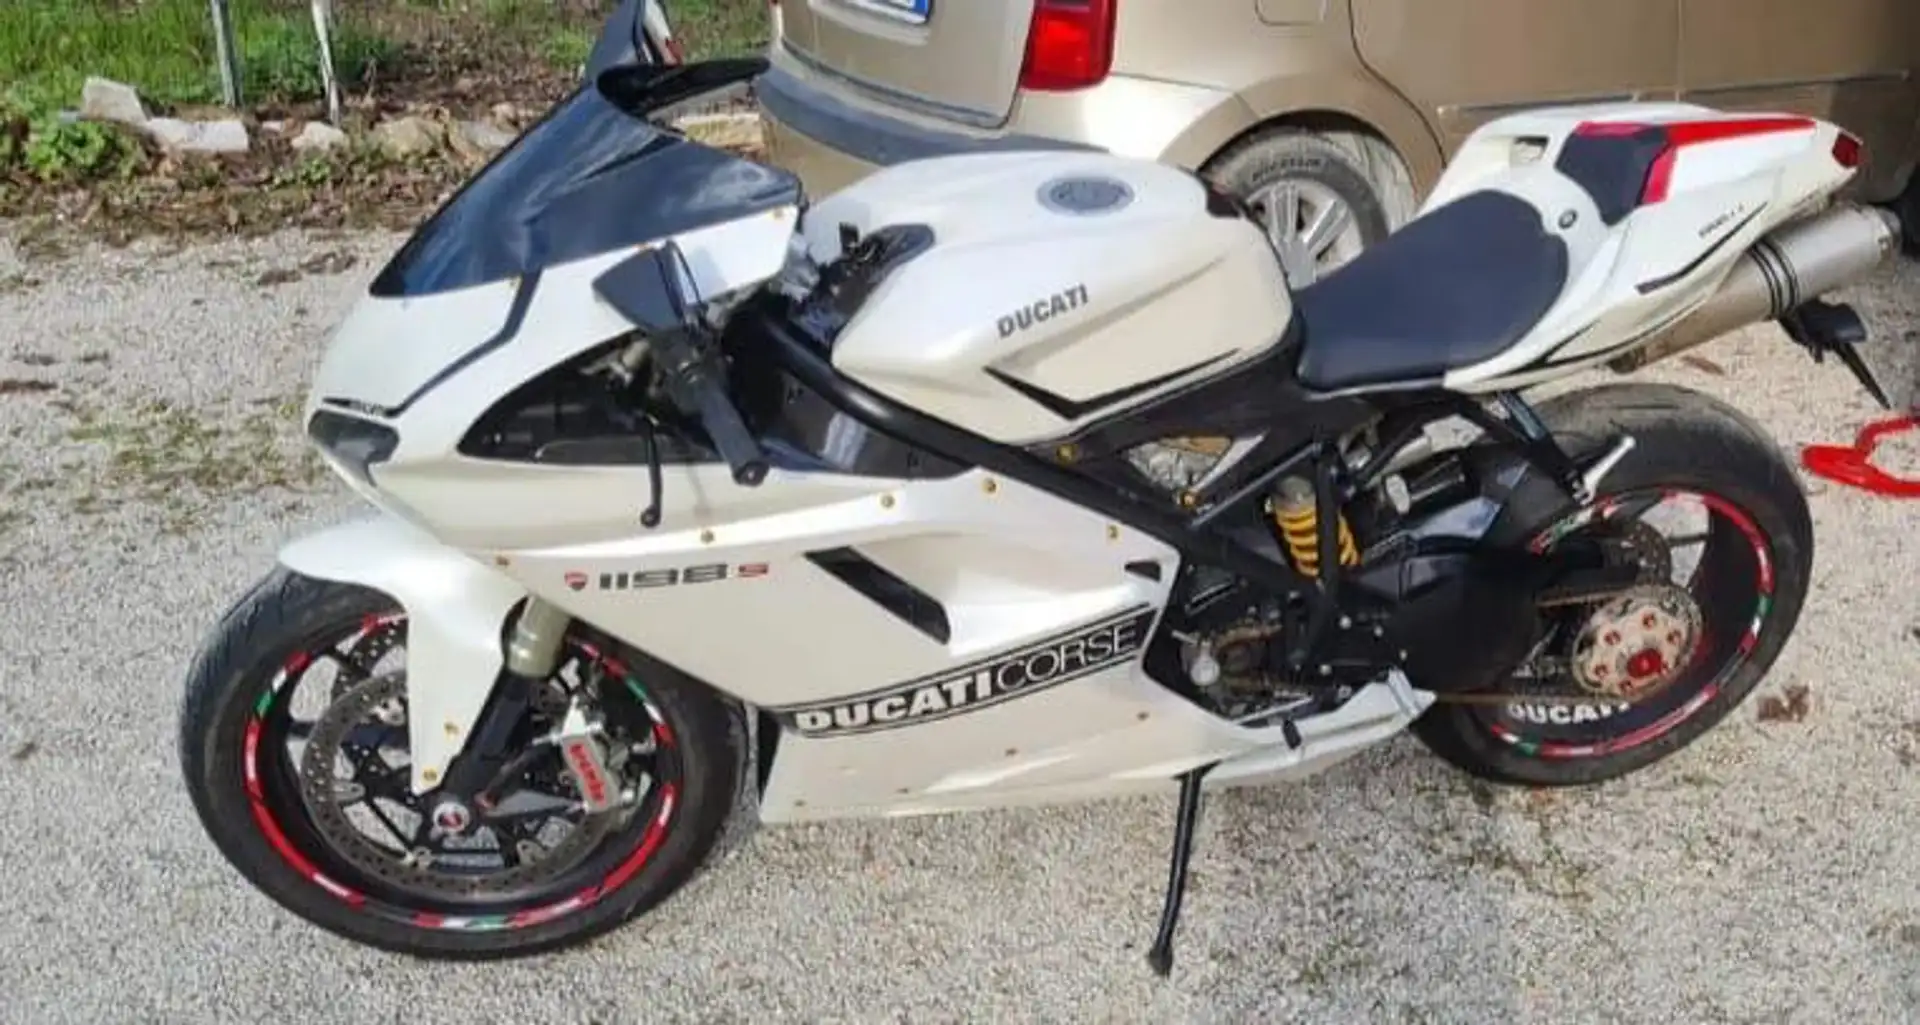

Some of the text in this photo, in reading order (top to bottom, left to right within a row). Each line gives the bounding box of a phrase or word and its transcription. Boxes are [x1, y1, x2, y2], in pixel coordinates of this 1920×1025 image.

[997, 283, 1089, 338] DUCATI
[600, 564, 727, 589] 1198
[795, 620, 1138, 732] DUCATI CORSE
